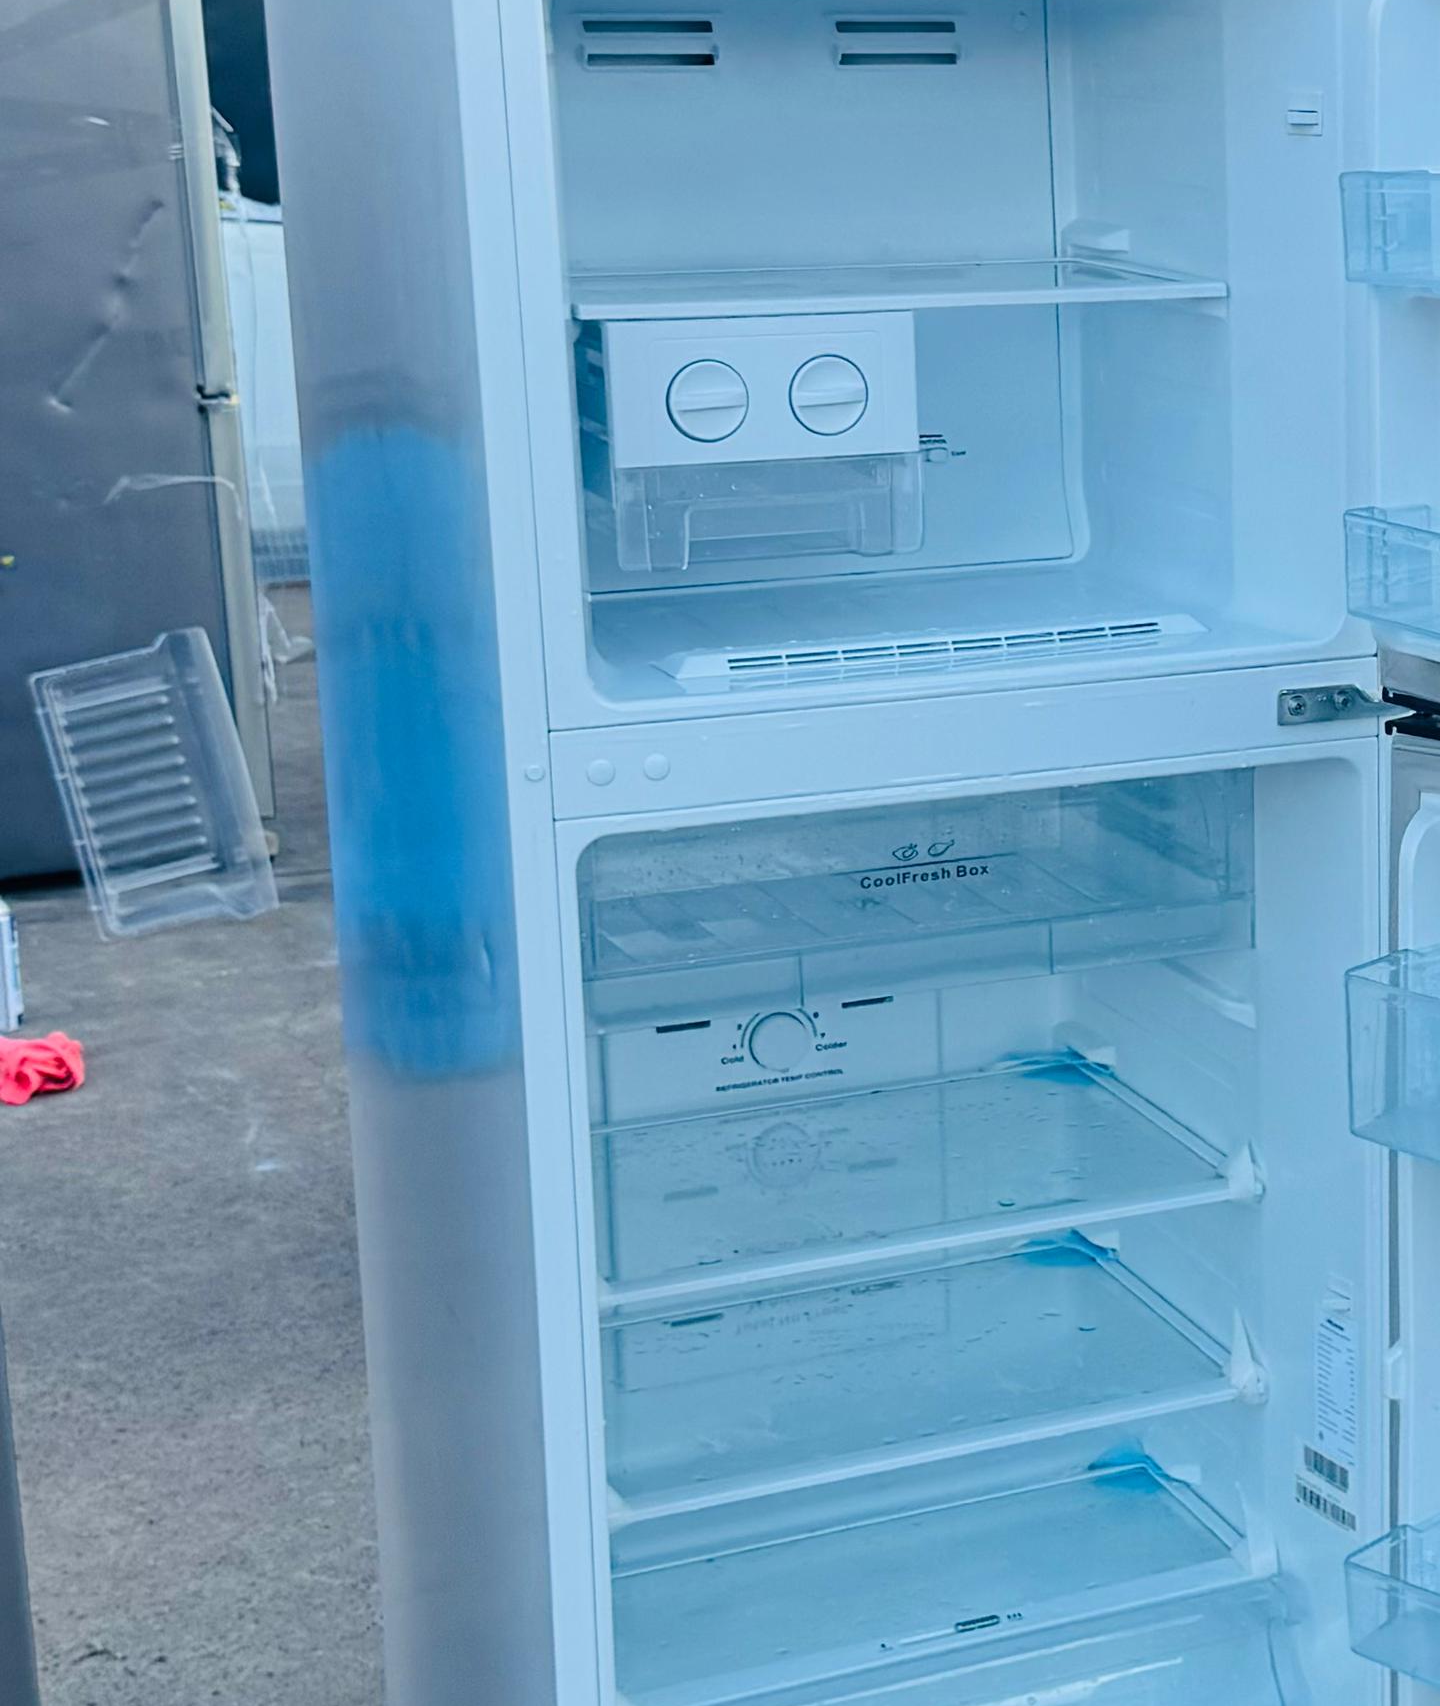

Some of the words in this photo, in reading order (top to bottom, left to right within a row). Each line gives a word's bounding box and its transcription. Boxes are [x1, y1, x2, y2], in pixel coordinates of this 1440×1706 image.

[860, 868, 950, 889] CoolFresh
[956, 865, 989, 878] Box
[721, 1056, 744, 1065] Cold
